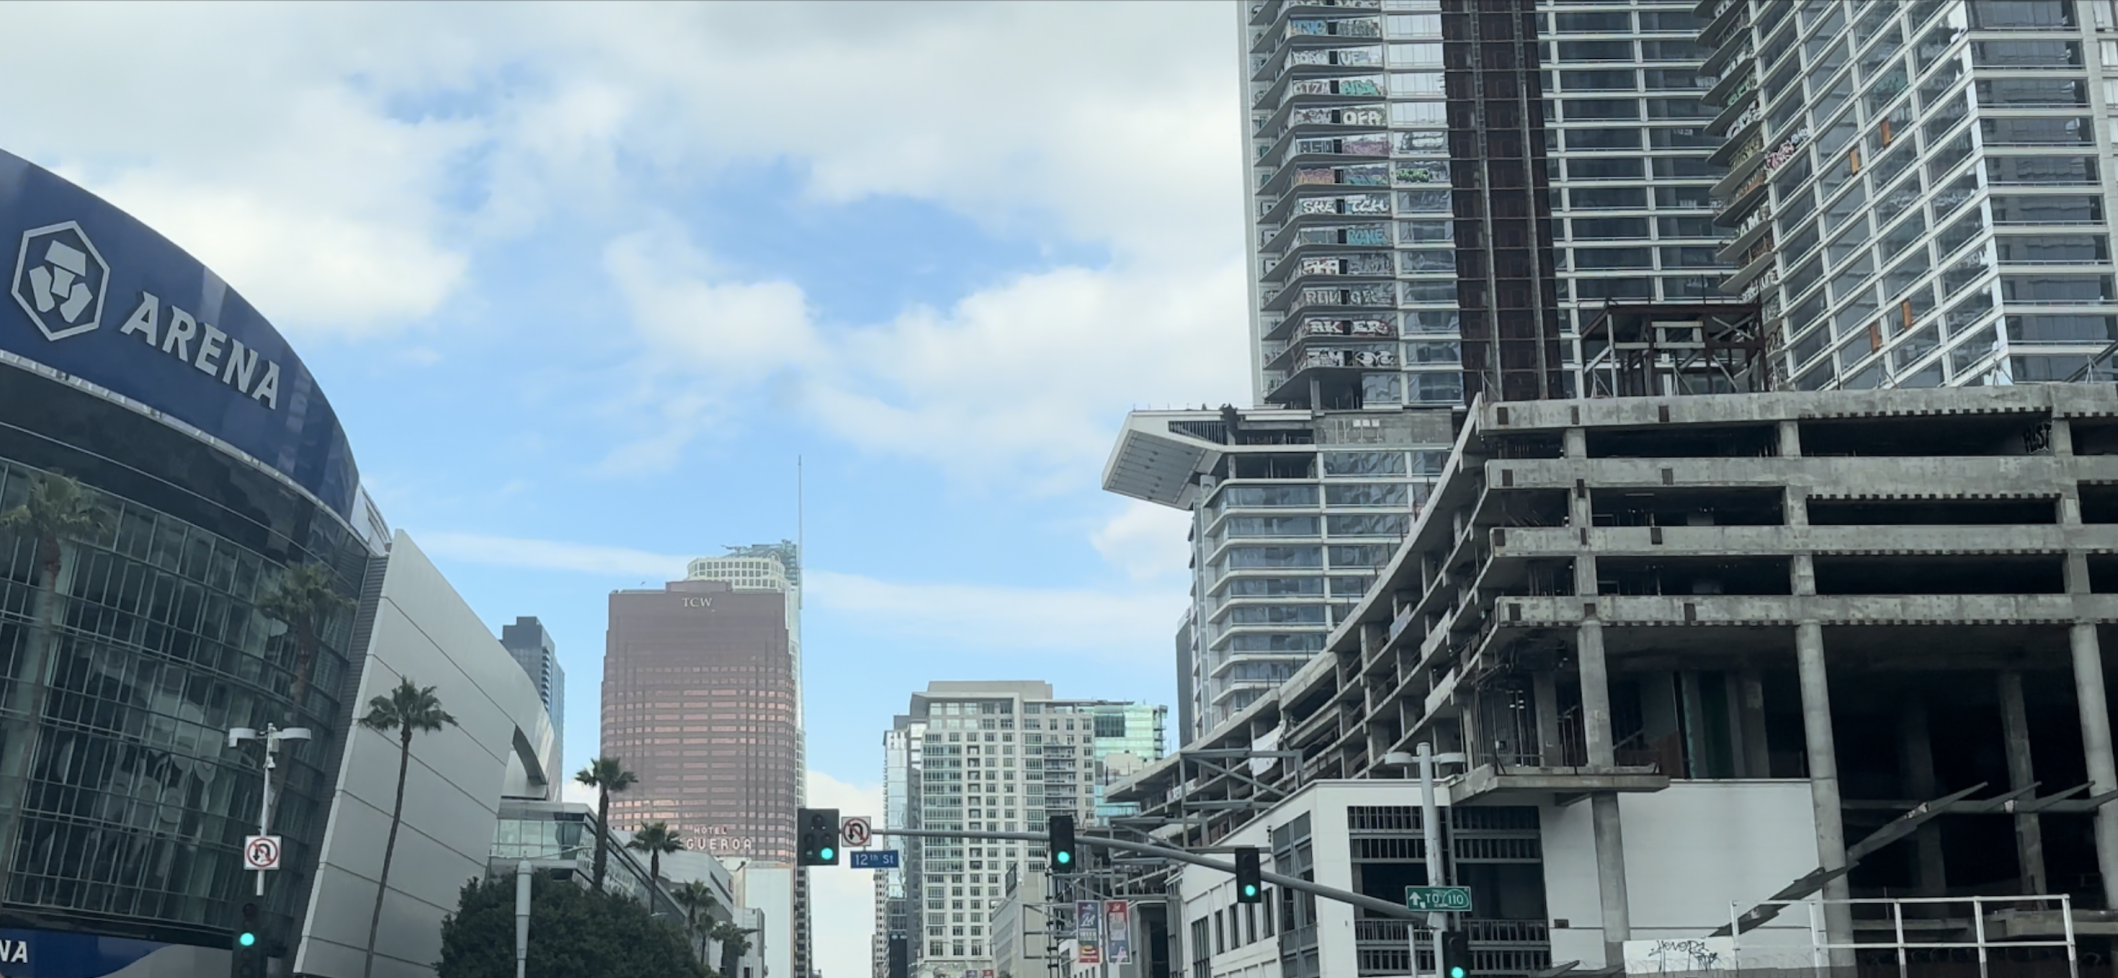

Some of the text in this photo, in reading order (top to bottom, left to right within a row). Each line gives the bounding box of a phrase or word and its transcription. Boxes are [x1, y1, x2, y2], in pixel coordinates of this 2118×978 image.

[120, 291, 280, 410] ARENA
[681, 597, 713, 608] TCW
[694, 826, 727, 835] HOTEL
[685, 838, 752, 851] GUEROA
[855, 853, 894, 866] 12th St
[1425, 893, 1464, 905] TO 110
